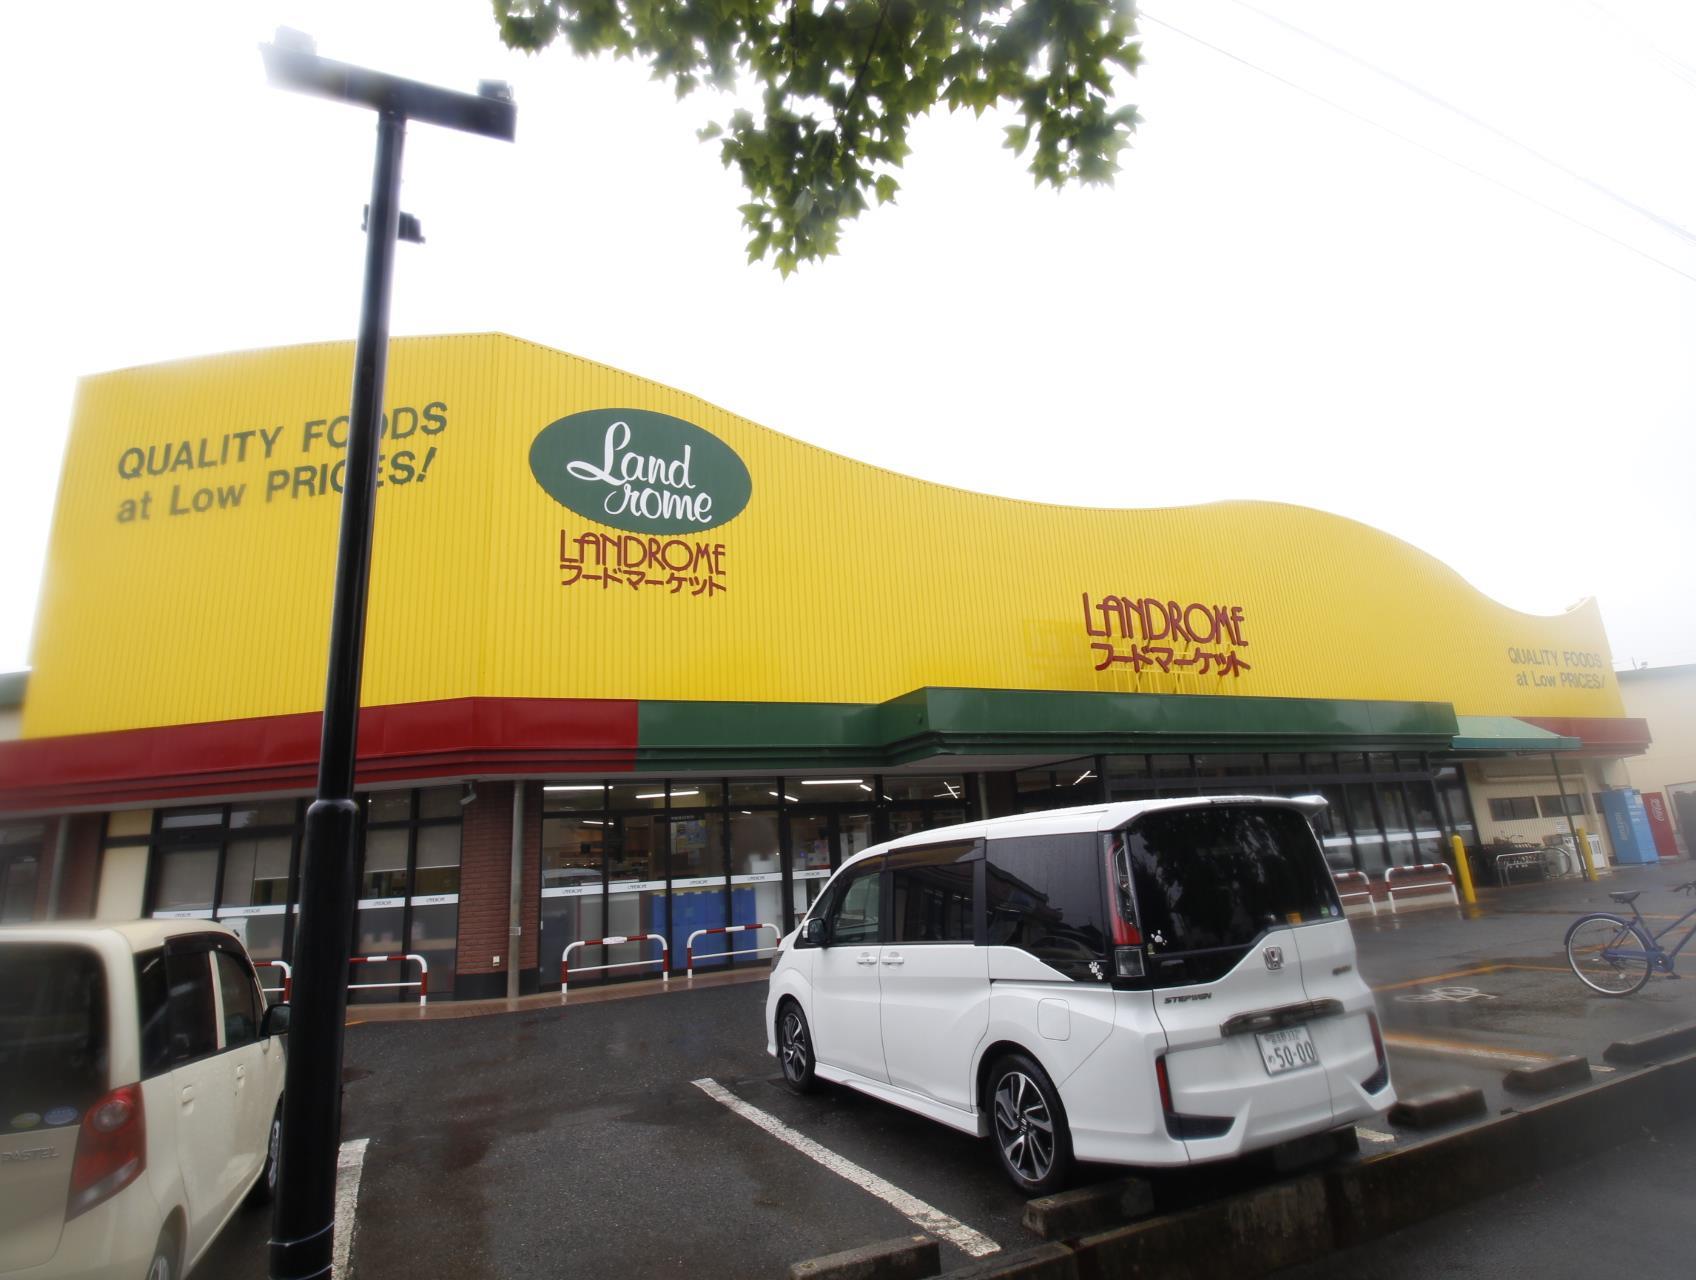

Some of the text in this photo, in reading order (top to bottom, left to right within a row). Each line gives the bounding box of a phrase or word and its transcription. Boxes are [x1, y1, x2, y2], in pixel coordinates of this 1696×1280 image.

[117, 426, 284, 480] QUALITY
[566, 421, 696, 488] Land
[116, 491, 152, 524] at
[169, 484, 246, 516] Low
[604, 483, 712, 523] rome
[560, 529, 726, 576] LANDROME
[560, 564, 727, 597] フードマーケット
[1083, 592, 1249, 646] LANDROME
[1091, 642, 1251, 677] フードマーケット
[1508, 647, 1559, 666] QUALITY
